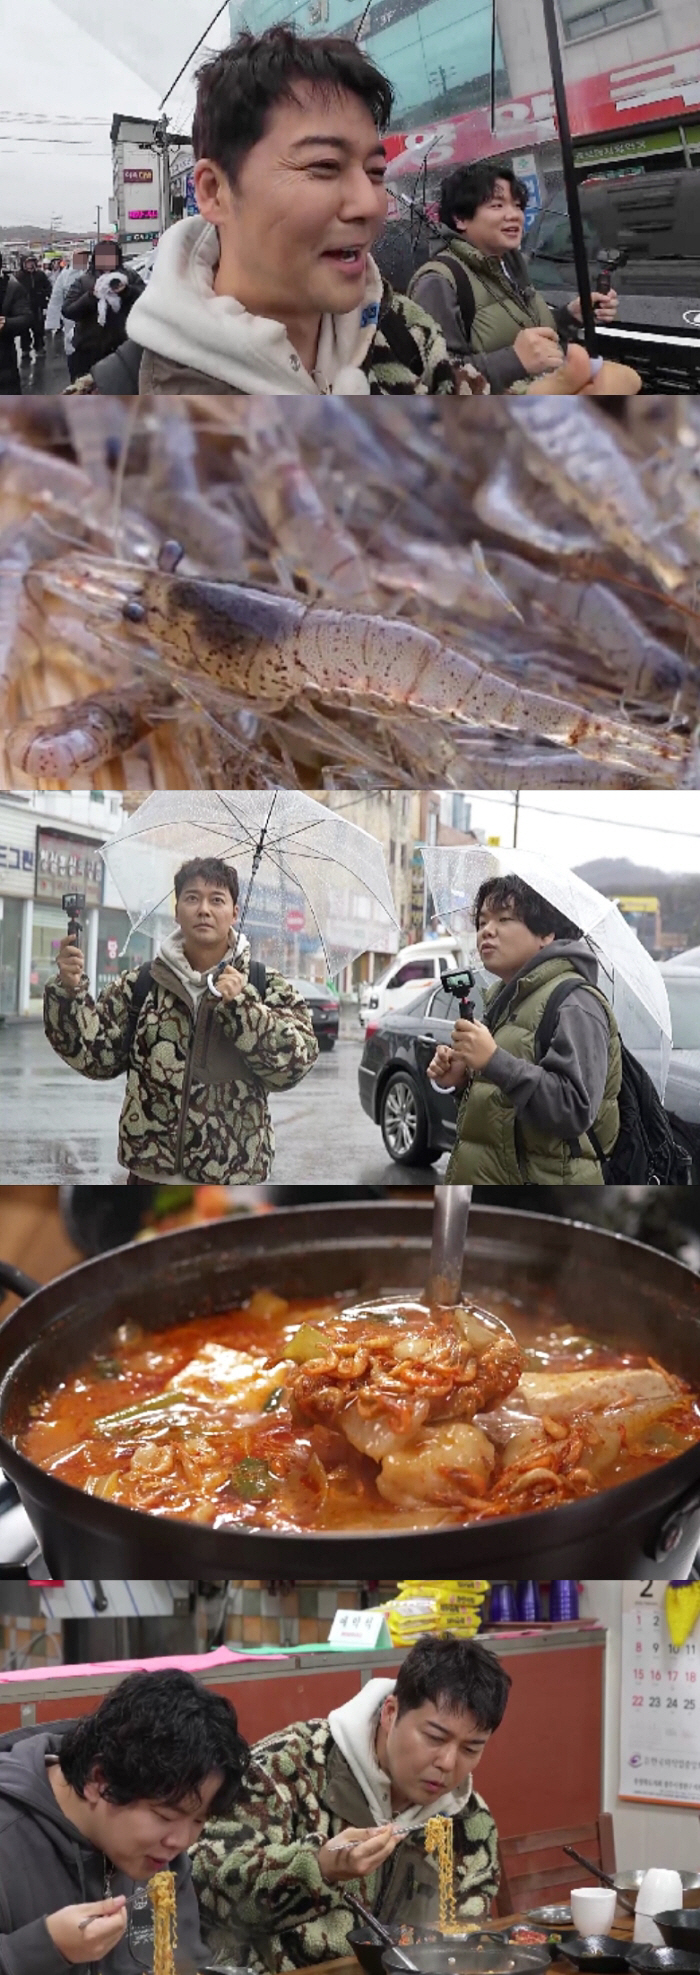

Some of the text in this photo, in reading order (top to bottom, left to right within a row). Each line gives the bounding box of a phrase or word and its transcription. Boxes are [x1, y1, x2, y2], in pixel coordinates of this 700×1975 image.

[636, 1615, 660, 1627] 1 2
[635, 1641, 643, 1654] 8
[652, 1642, 660, 1654] 9
[686, 1644, 696, 1655] 11
[633, 1668, 697, 1683] 15 16 17 18
[632, 1695, 696, 1710] 22 23 24 25
